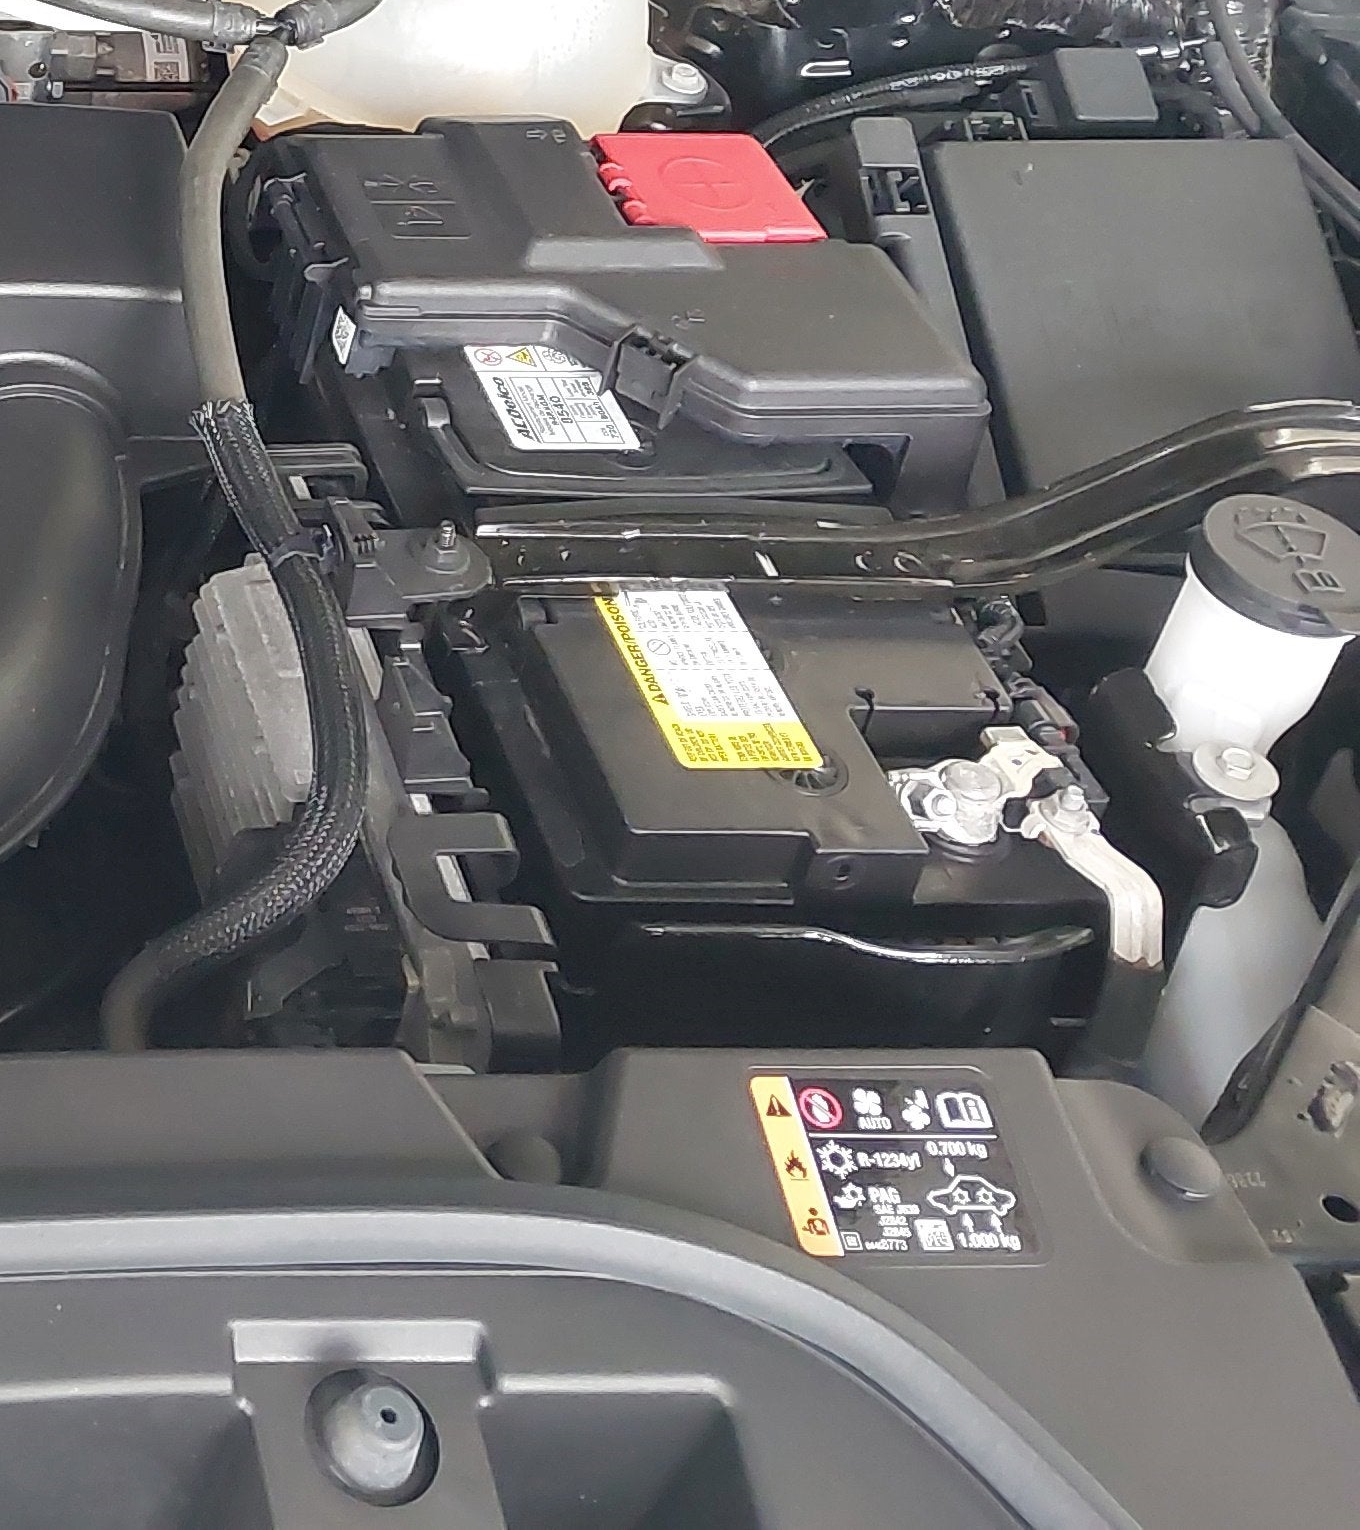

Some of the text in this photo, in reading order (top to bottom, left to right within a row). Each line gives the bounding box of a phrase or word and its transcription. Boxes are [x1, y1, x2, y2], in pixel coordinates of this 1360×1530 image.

[493, 376, 536, 443] ACDelco
[603, 597, 662, 697] DANGER/POISON
[858, 1116, 892, 1131] AUTO
[967, 1142, 988, 1160] kg
[867, 1185, 902, 1205] PAG
[1000, 1234, 1022, 1252] kg
